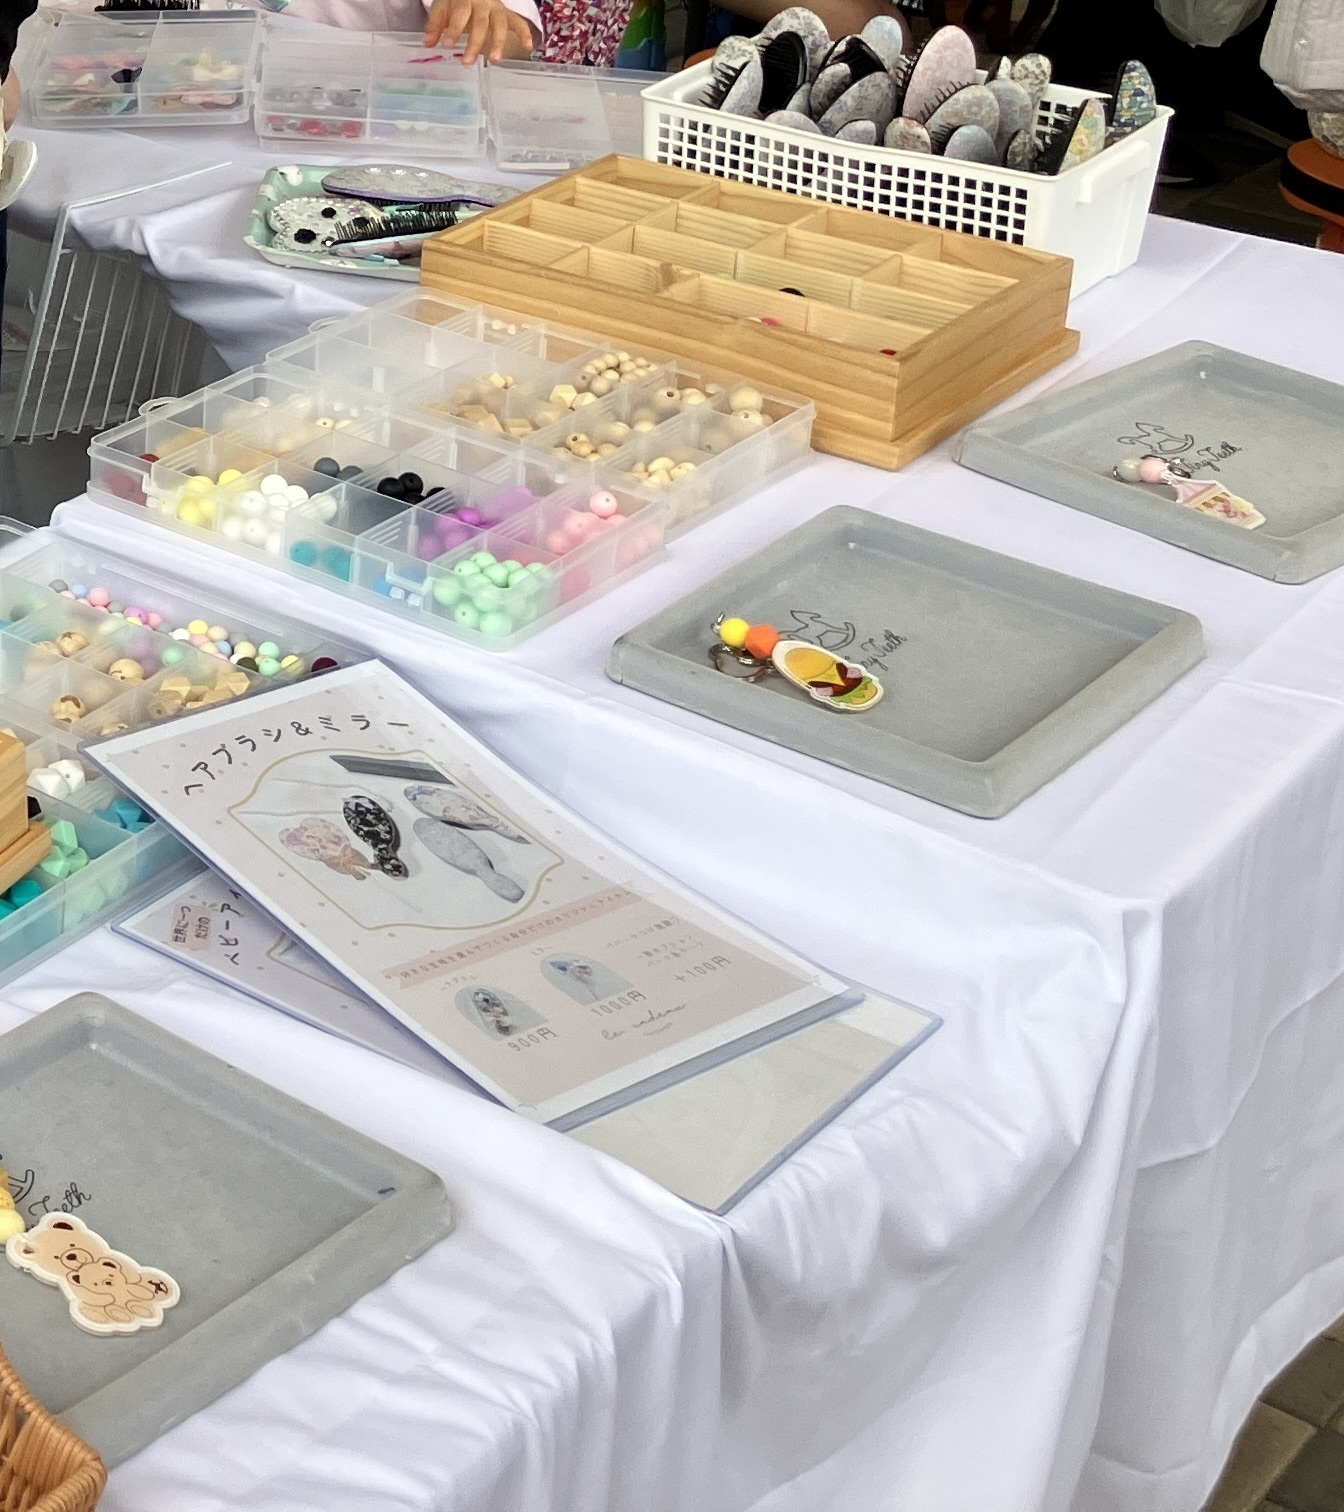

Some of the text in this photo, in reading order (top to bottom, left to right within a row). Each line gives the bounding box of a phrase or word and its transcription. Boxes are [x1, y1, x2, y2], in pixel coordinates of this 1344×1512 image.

[183, 711, 412, 798] ヘアブラシ&ミラー
[589, 990, 648, 1018] 1000円
[507, 1026, 558, 1054] 900円
